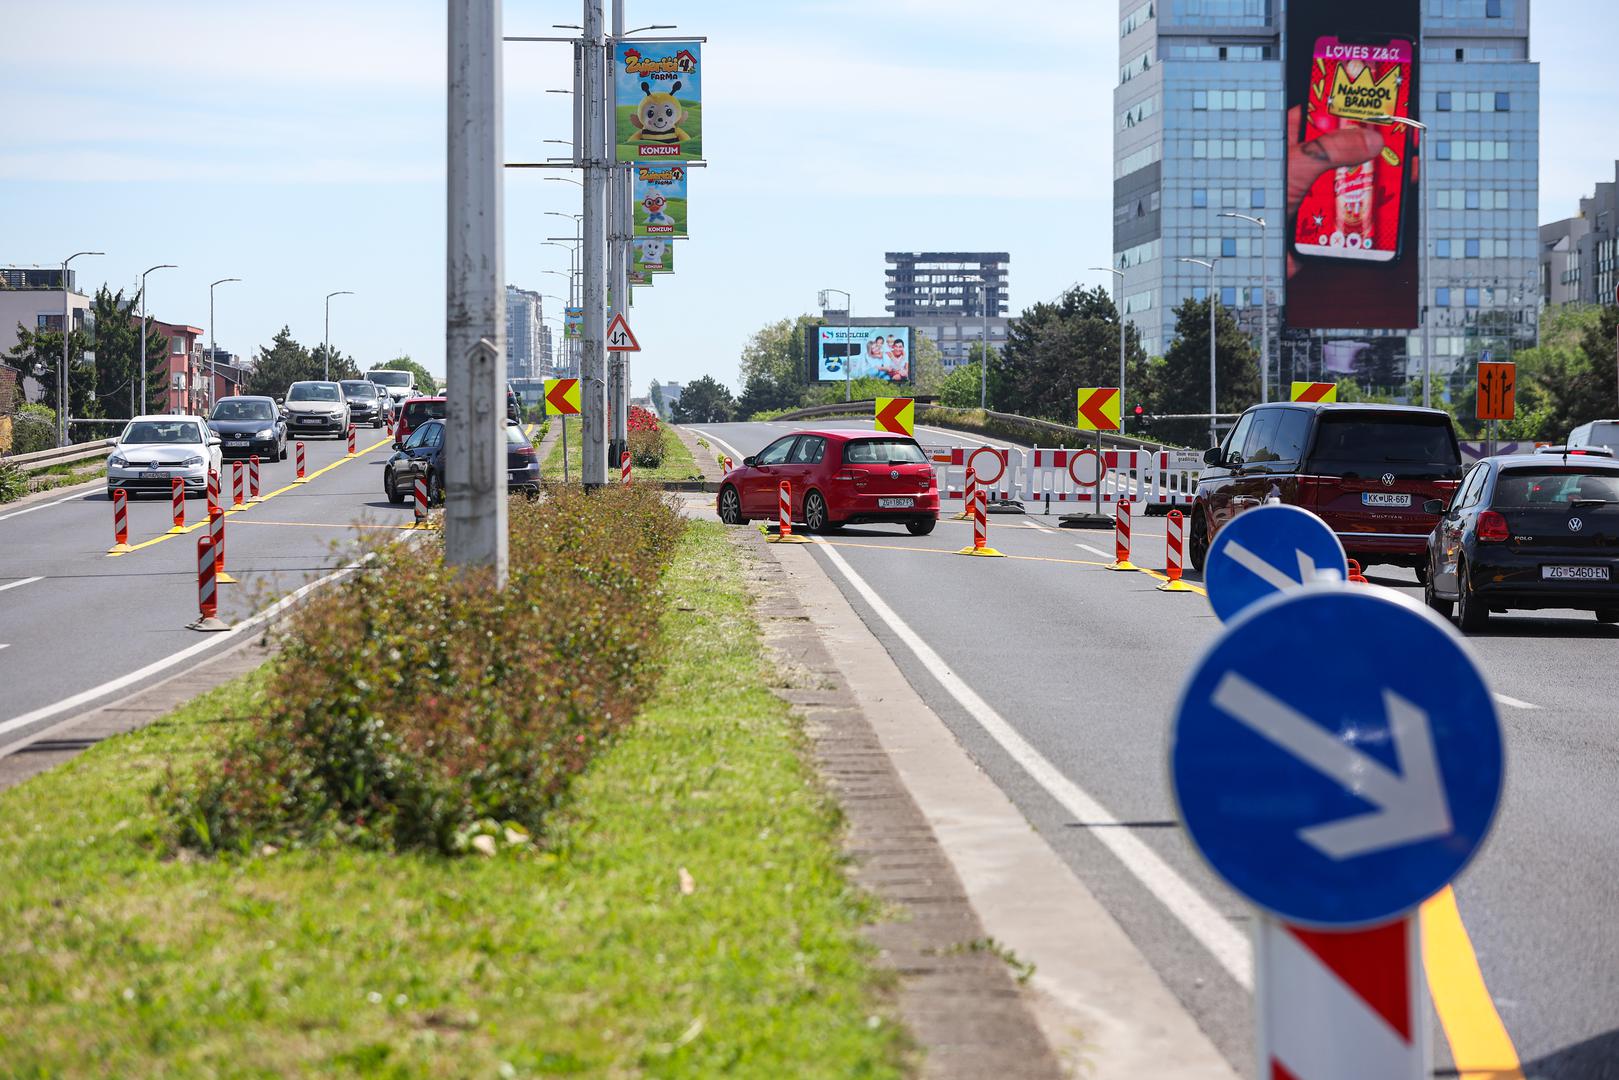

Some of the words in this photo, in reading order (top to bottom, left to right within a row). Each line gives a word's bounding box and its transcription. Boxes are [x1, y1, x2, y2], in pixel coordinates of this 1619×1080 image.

[1344, 96, 1382, 109] BRAND
[640, 146, 679, 155] KONZUM
[1550, 567, 1562, 578] ZG
